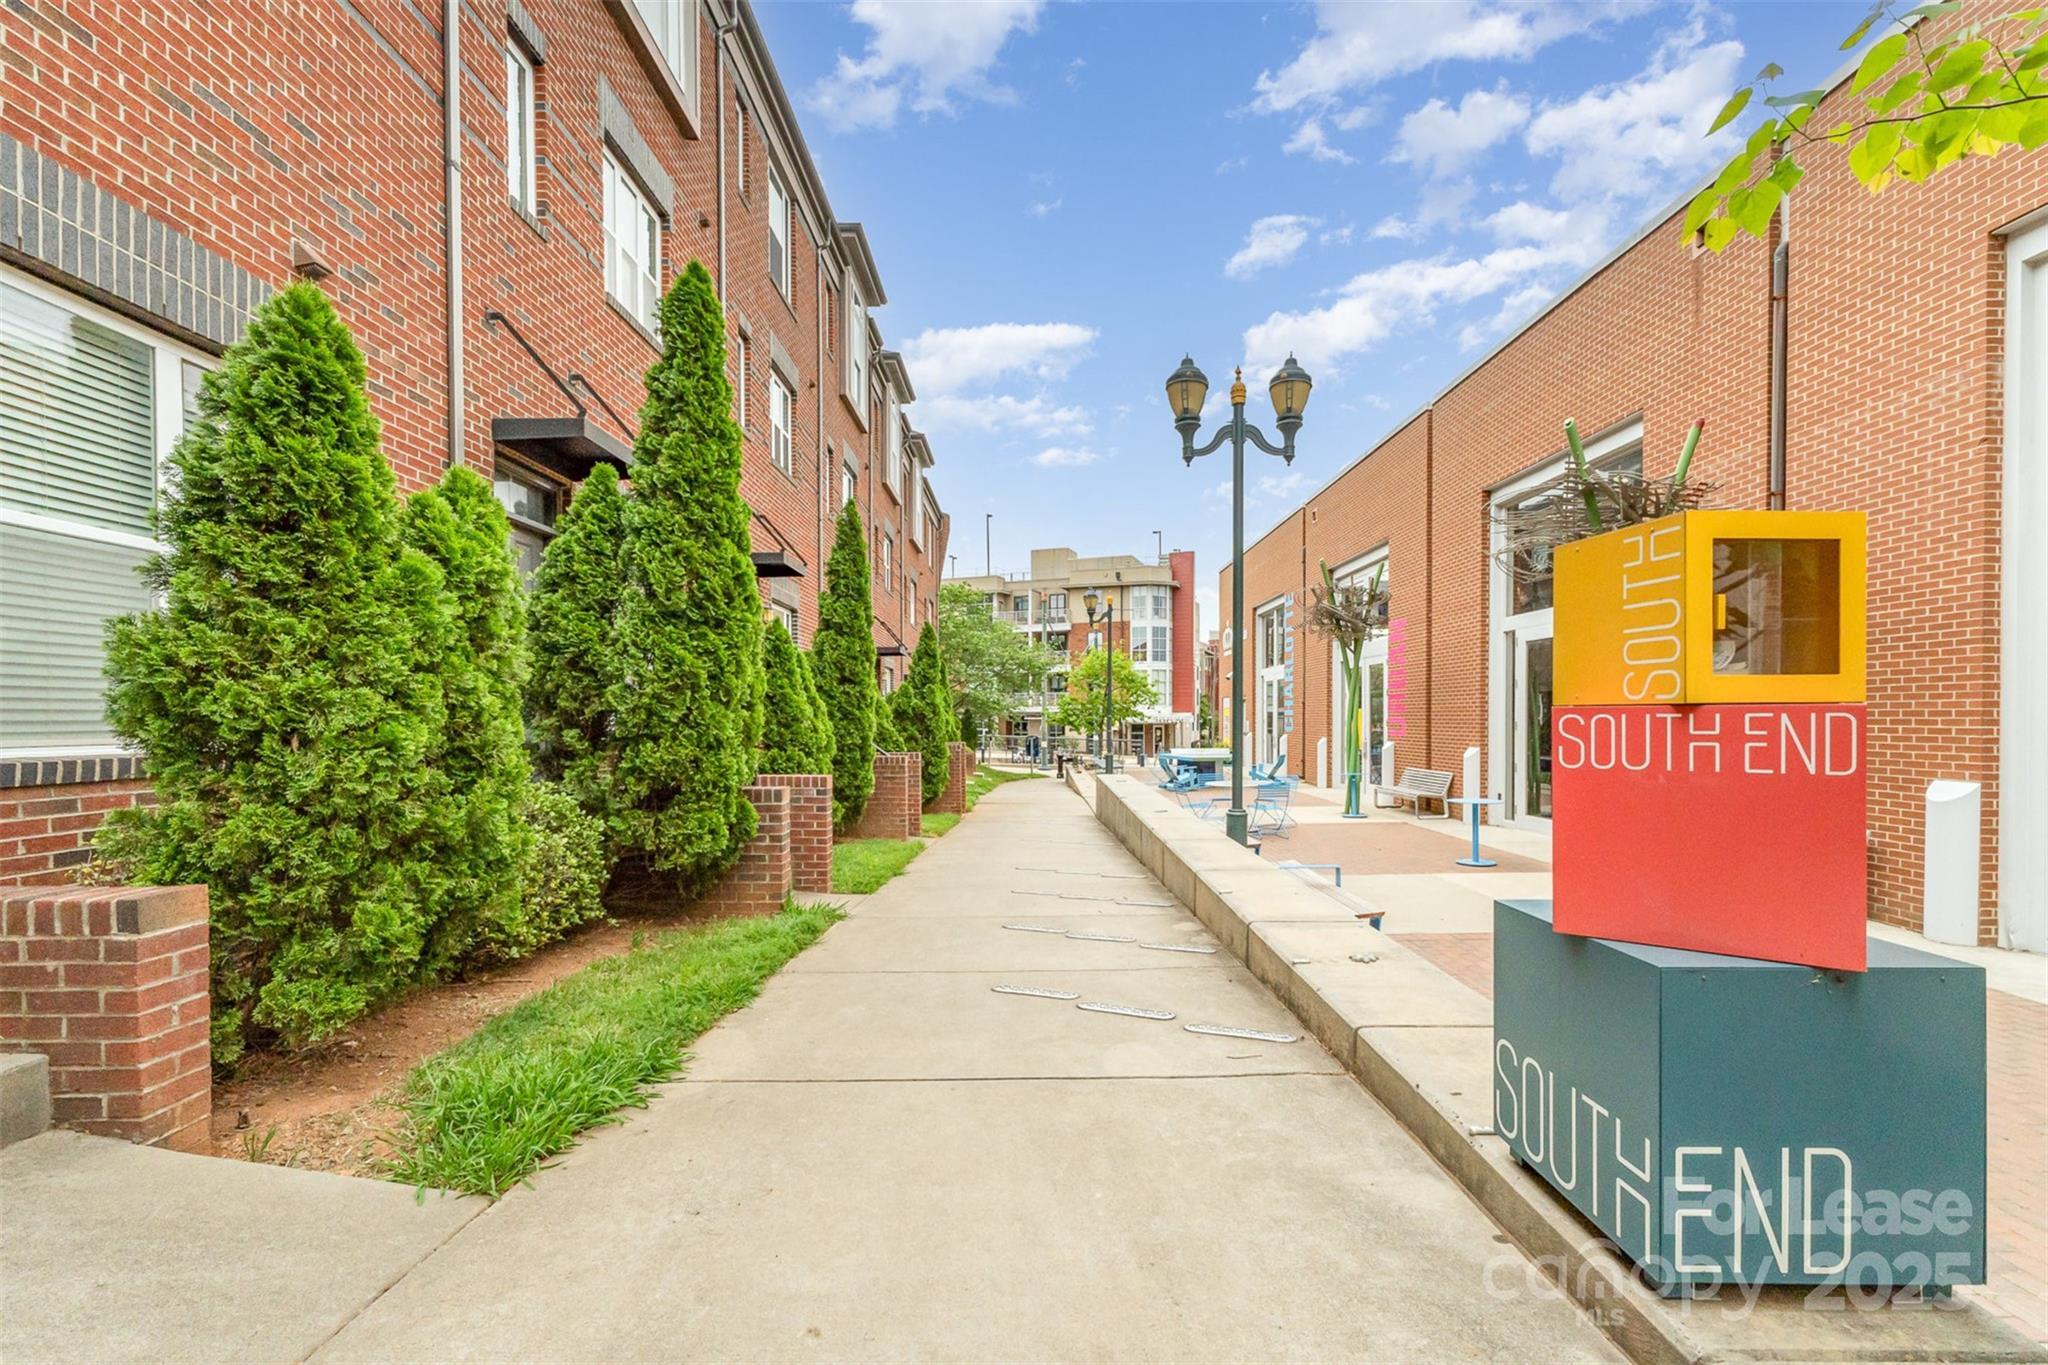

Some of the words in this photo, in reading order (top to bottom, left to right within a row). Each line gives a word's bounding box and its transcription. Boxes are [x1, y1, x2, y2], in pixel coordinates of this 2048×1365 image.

[1284, 592, 1295, 733] CHARLOTTE
[1622, 524, 1682, 700] SOUTH
[1557, 713, 1721, 773] SOUTH
[1744, 712, 1858, 776] END
[1496, 1039, 1651, 1265] SOUTH
[1674, 1147, 1852, 1275] END
